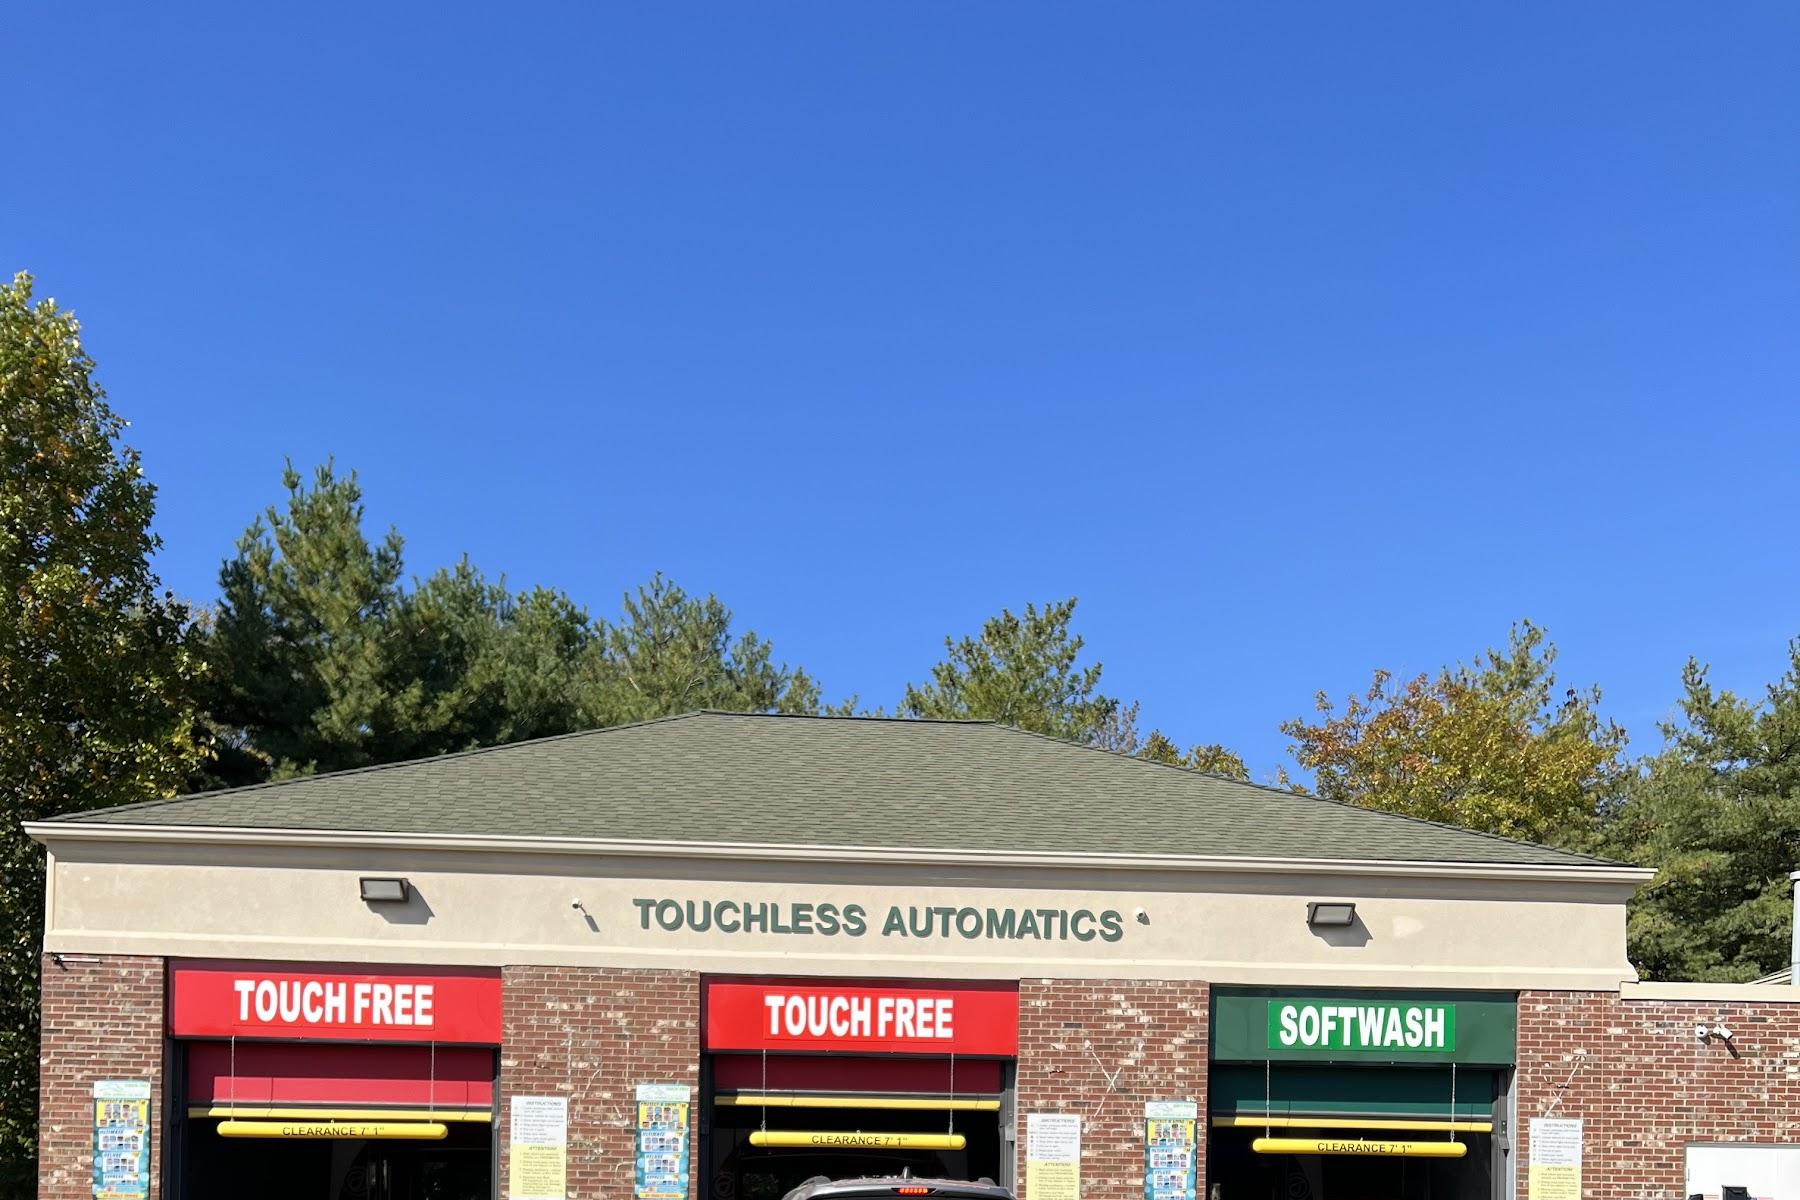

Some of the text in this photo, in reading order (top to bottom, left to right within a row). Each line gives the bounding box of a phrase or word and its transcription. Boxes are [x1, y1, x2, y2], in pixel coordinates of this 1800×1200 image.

[632, 898, 1124, 943] TOUCHLESS AUTOMATICS
[234, 979, 434, 1026] TOUCH FREE
[764, 995, 954, 1038] TOUCH FREE
[1279, 1005, 1445, 1048] SOFTWASH
[282, 1126, 357, 1137] CLEARANCE
[811, 1135, 882, 1146] CLEARANCE
[1317, 1142, 1386, 1153] CLEARANCE
